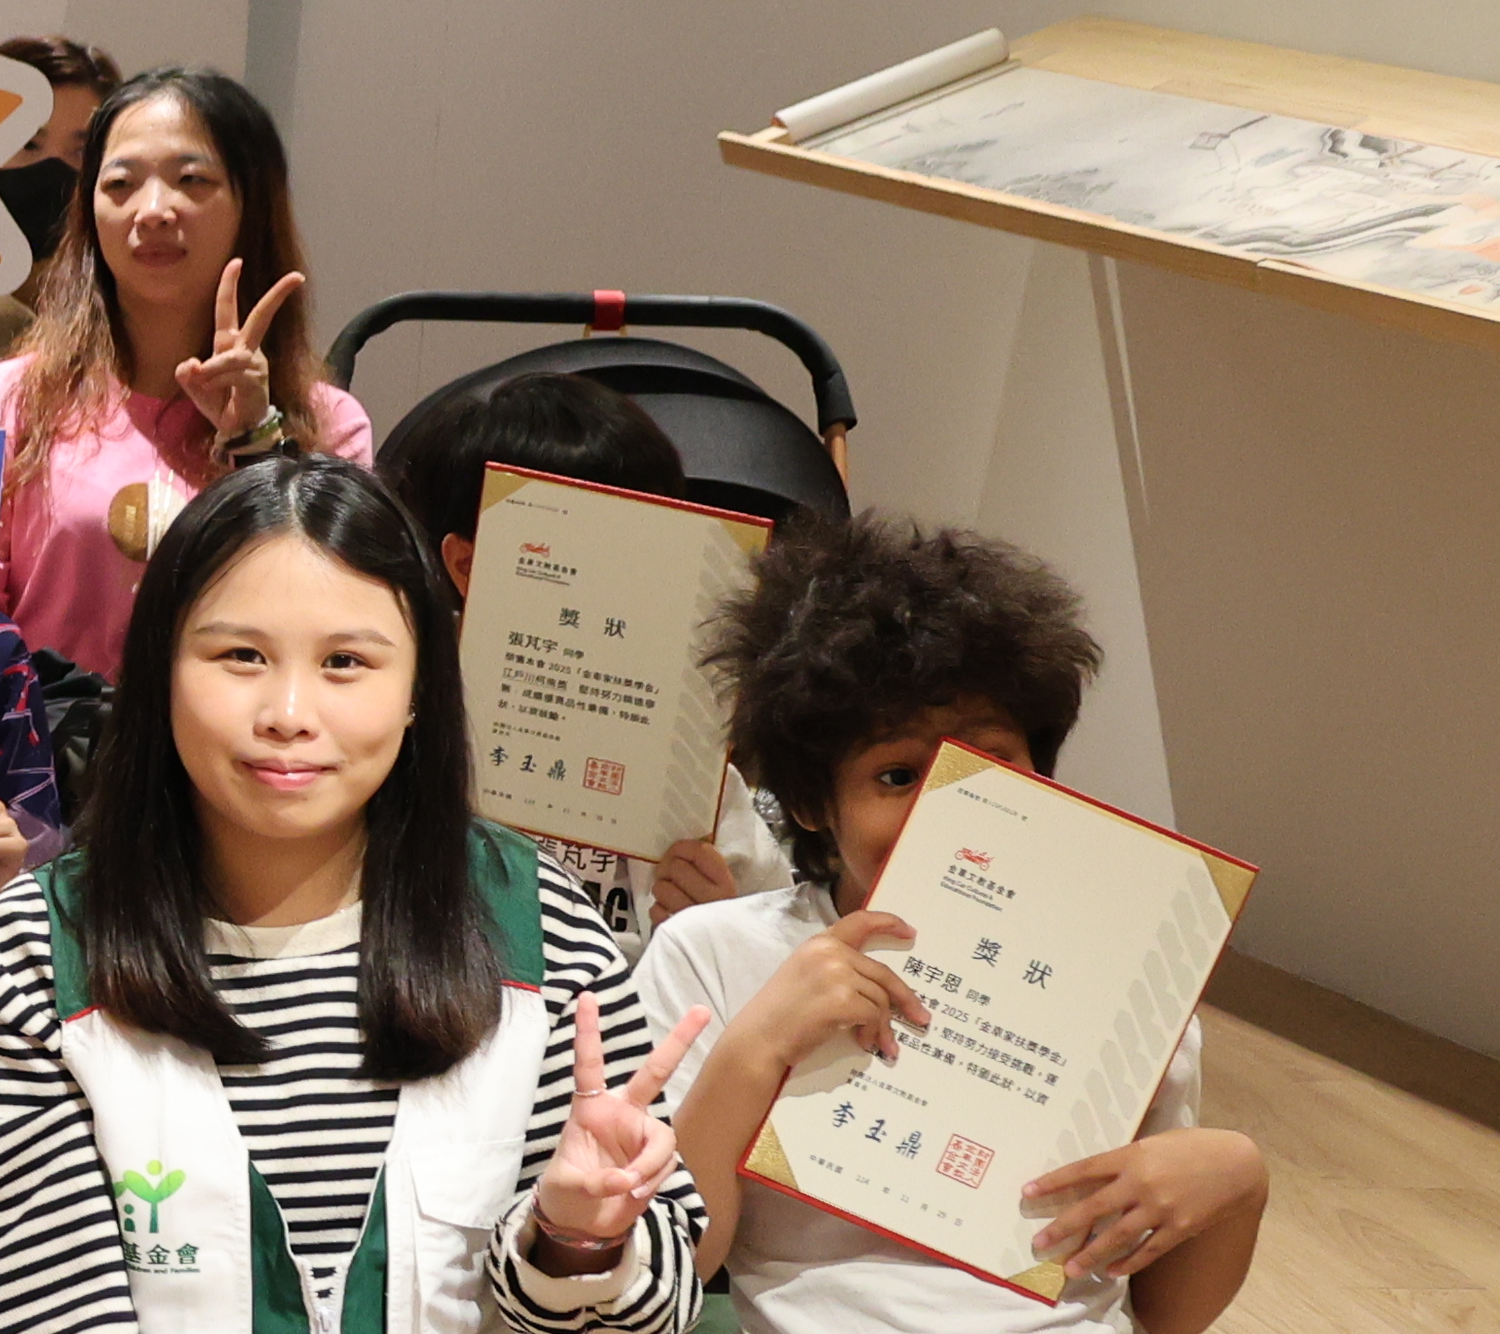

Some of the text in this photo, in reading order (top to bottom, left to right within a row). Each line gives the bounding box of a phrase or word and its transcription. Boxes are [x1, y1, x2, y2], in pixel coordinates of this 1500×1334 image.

[902, 954, 992, 1008] 陳宇恩 同學
